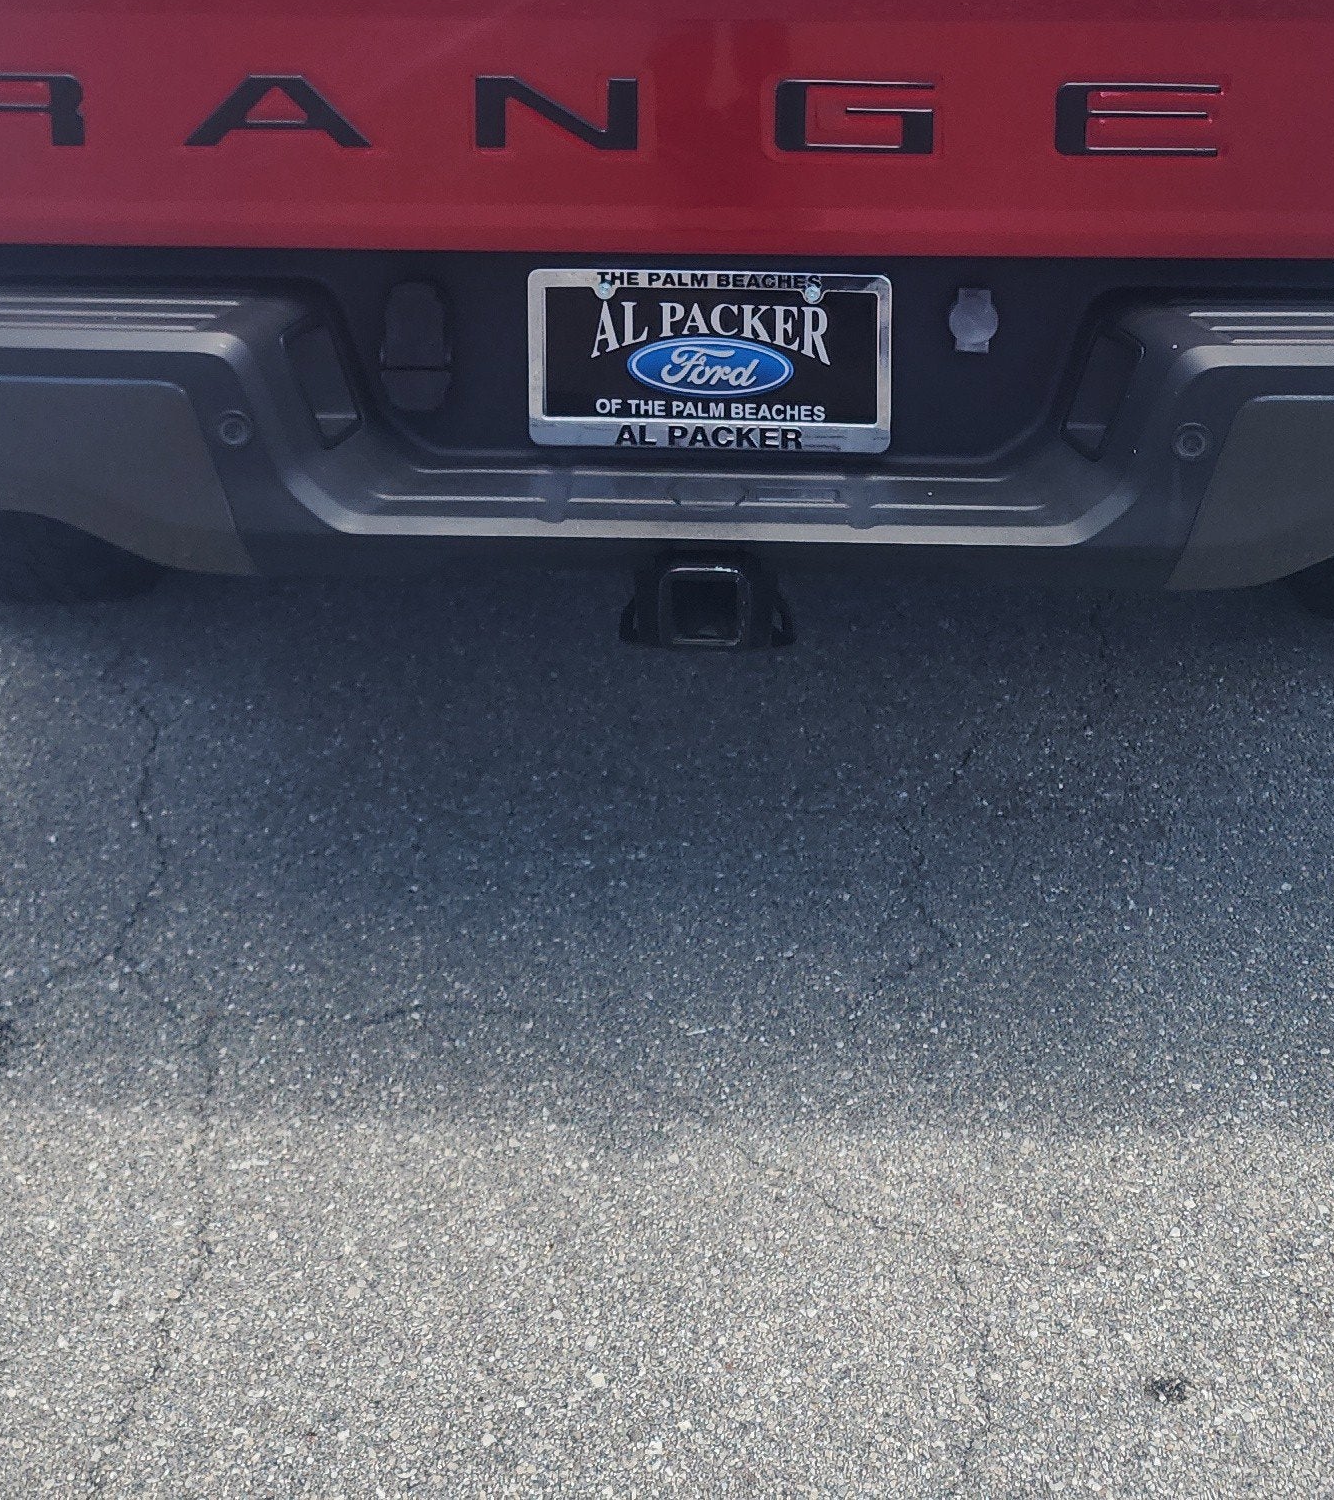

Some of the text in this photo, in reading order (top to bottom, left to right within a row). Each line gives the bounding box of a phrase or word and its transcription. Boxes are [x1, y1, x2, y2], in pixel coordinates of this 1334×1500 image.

[597, 272, 821, 290] THE PALM BEACHES
[591, 301, 831, 366] AL PACKER
[661, 346, 759, 387] Ford
[595, 399, 826, 422] OF THE PALM BEACHES
[615, 424, 803, 450] AL PACKER
